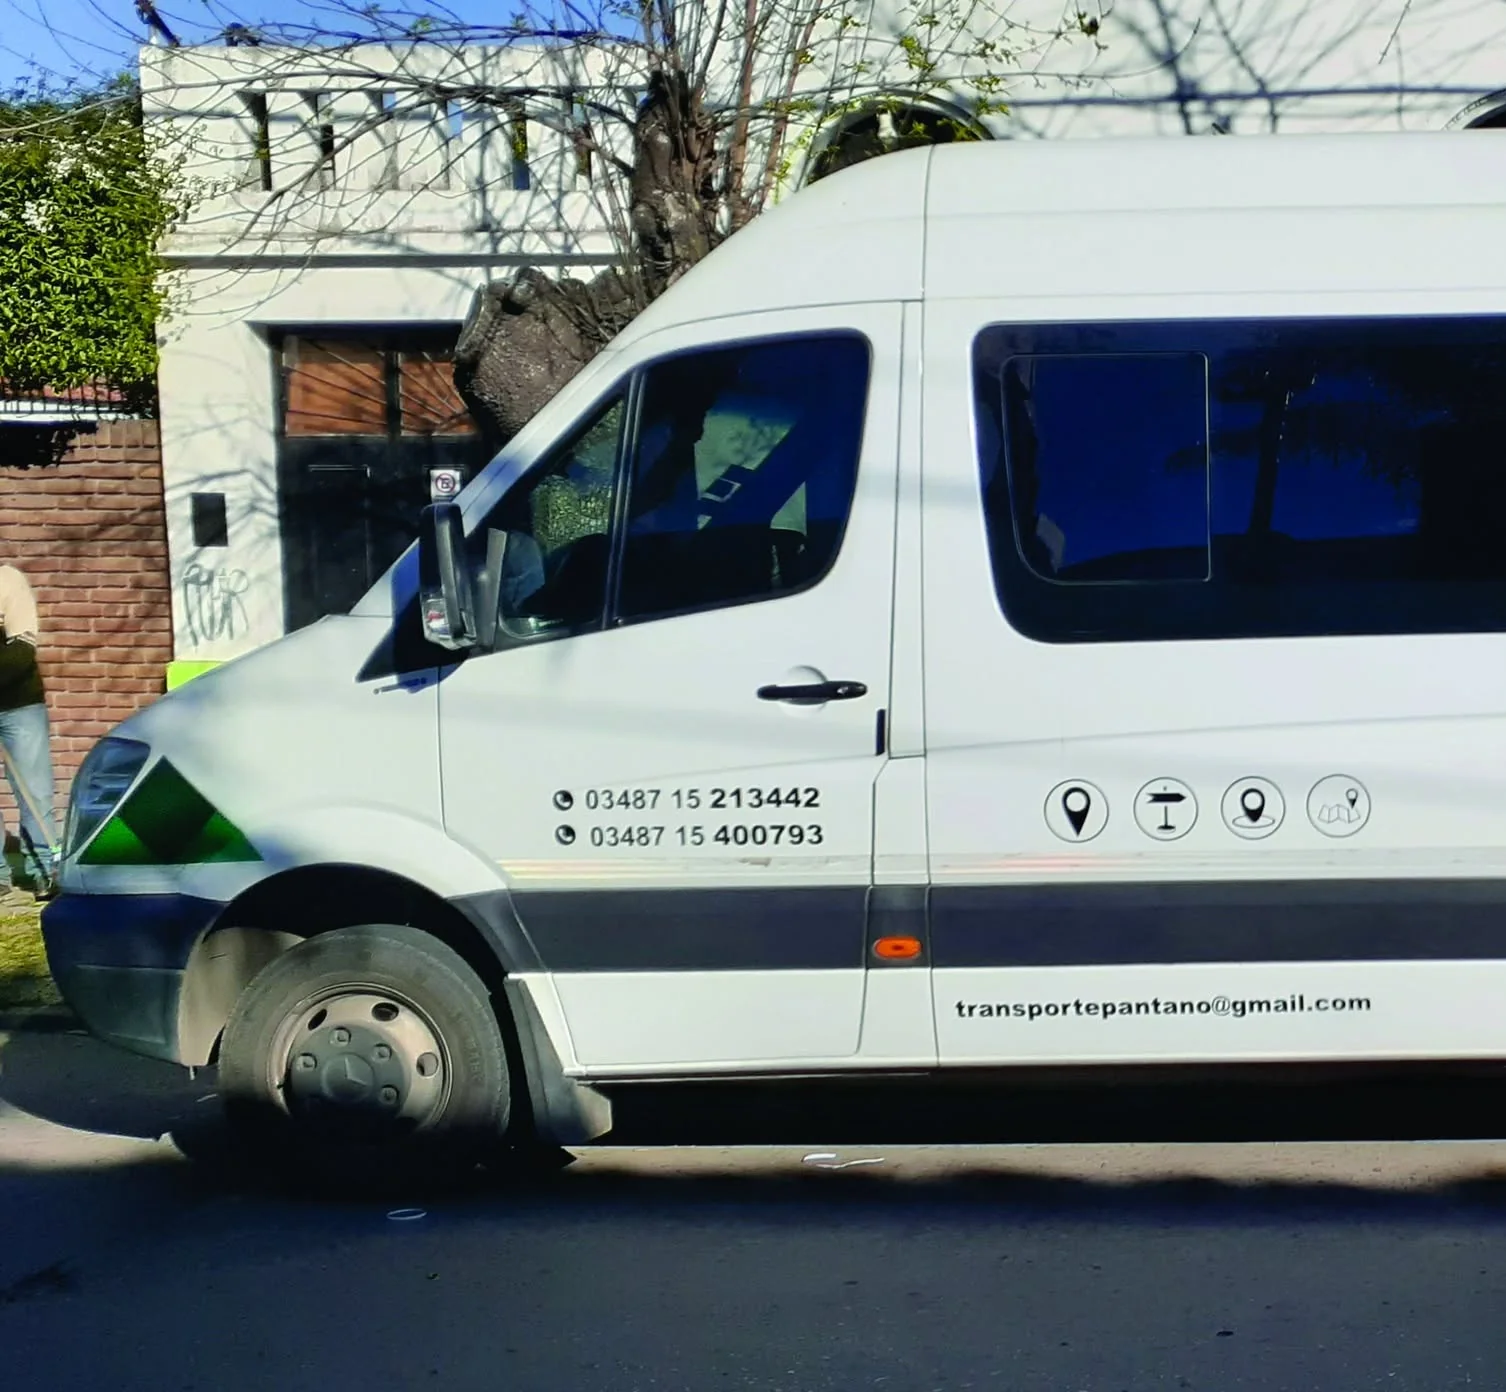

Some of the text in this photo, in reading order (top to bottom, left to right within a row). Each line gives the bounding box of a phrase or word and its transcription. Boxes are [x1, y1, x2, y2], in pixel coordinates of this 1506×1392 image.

[585, 787, 821, 810] 03487 15 213442
[590, 824, 824, 847] 03487 15 400793
[955, 994, 1372, 1021] transportepantano@gmail.com
